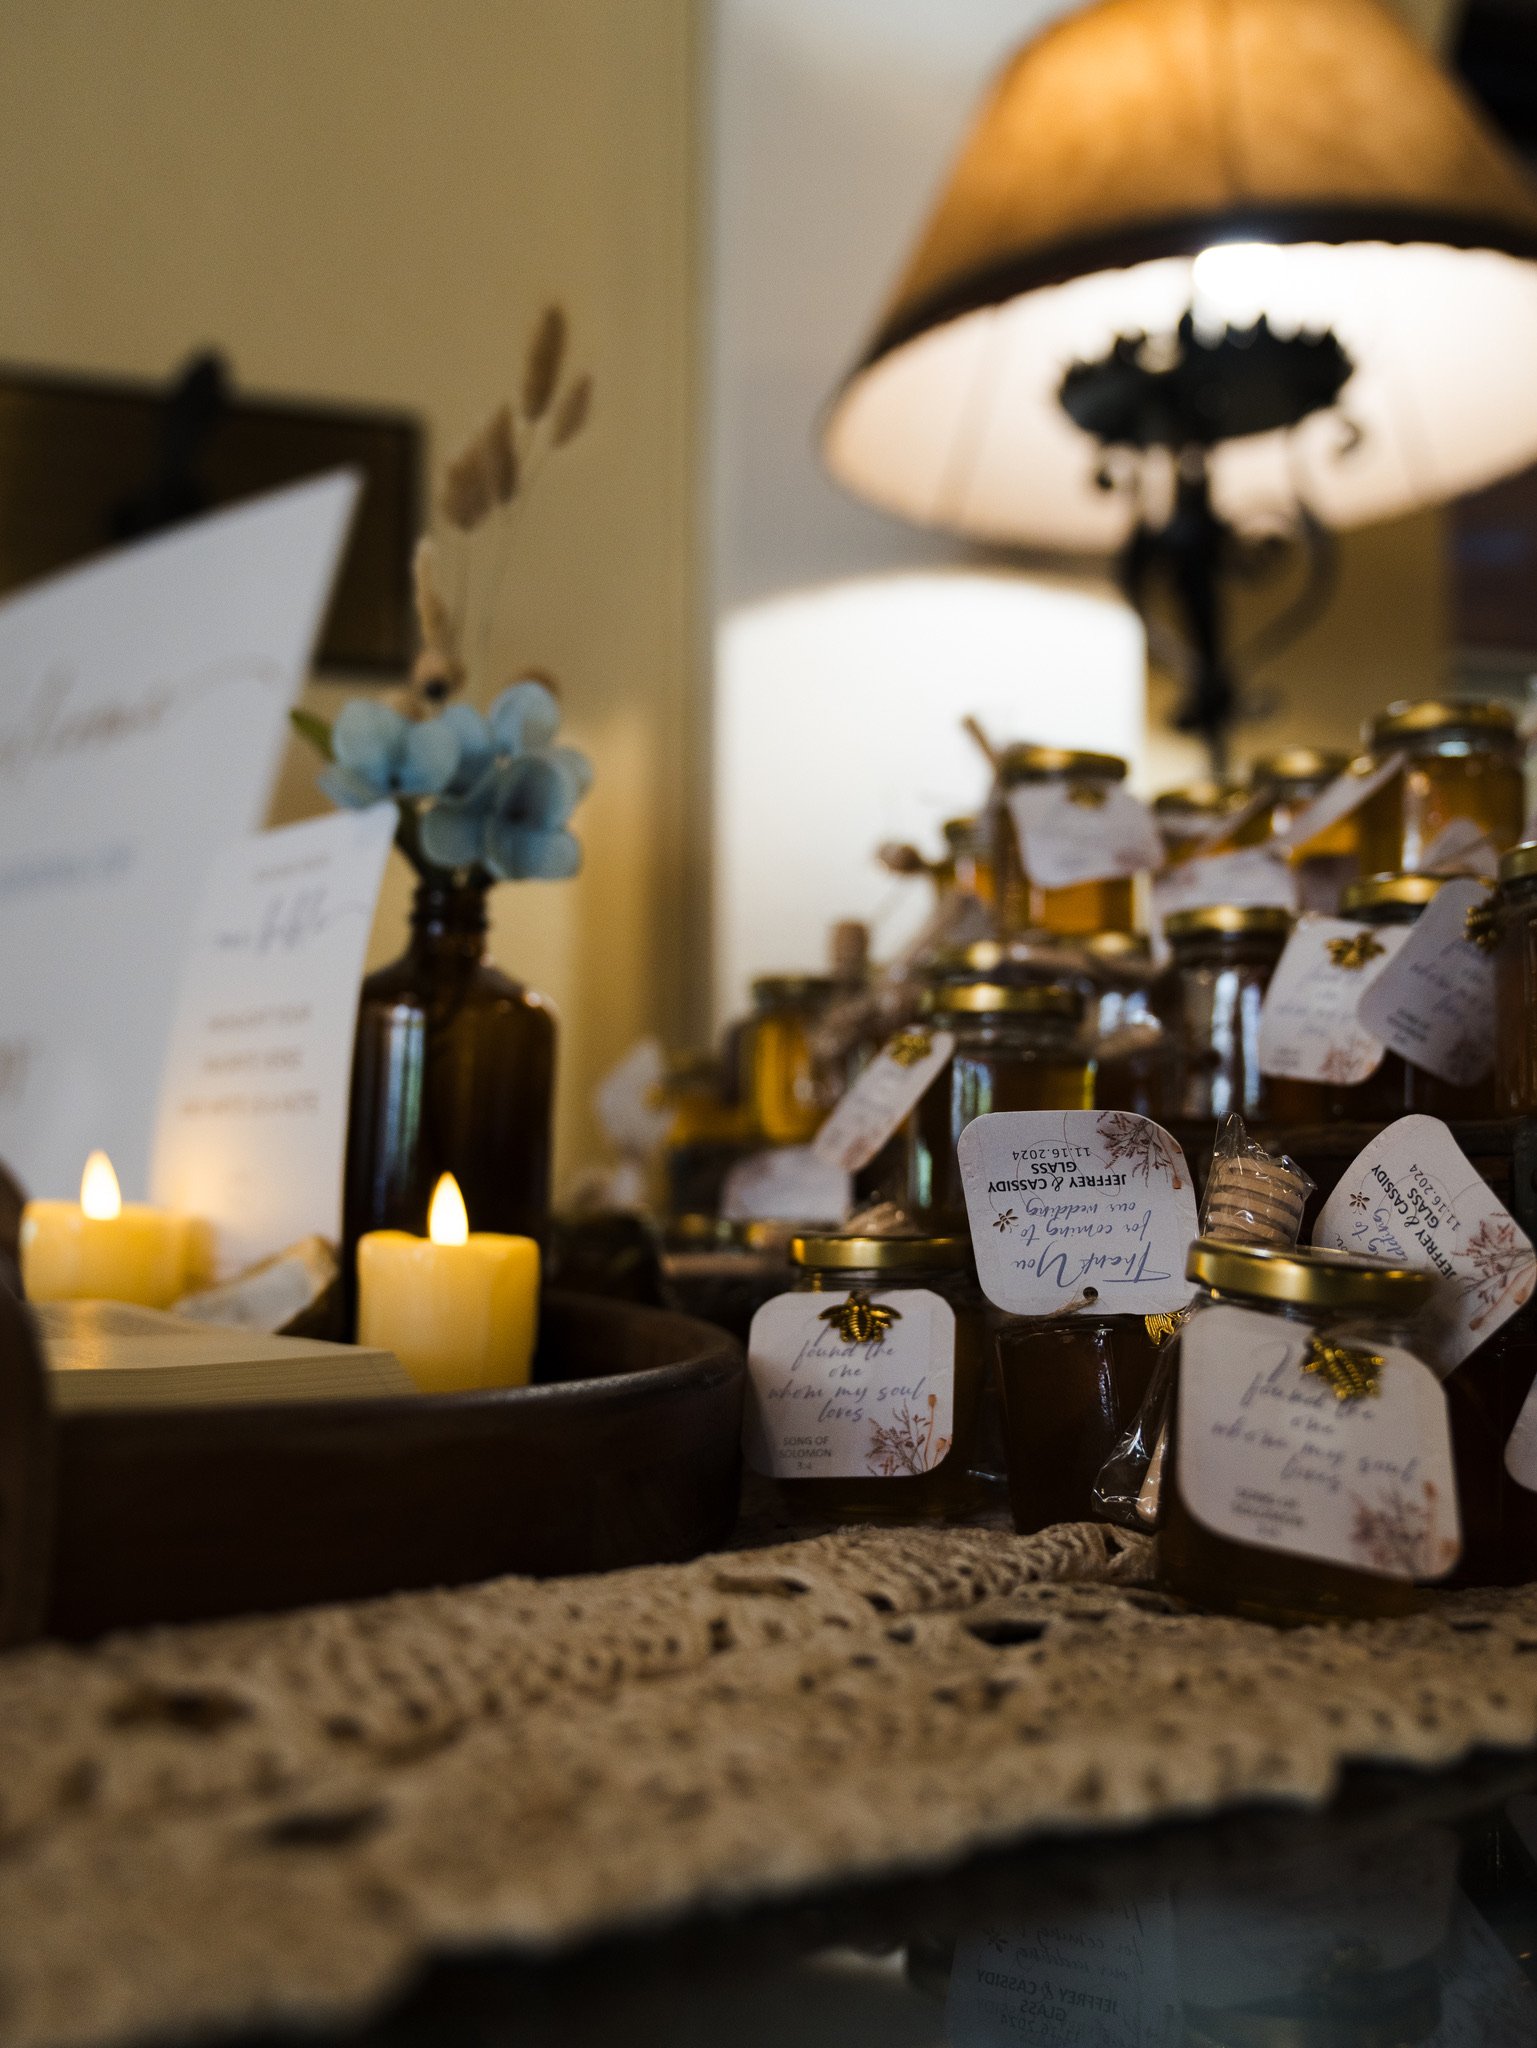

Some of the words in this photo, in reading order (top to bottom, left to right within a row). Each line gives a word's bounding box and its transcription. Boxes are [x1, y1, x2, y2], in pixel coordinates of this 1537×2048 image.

[1012, 1147, 1091, 1160] 11.16.2024
[1031, 1161, 1077, 1174] GLASS
[988, 1178, 1047, 1193] CASSIDY
[1051, 1177, 1064, 1192] &
[1068, 1174, 1127, 1188] JEFFREY
[1371, 1164, 1408, 1215] CASSIDY
[1026, 1198, 1098, 1220] wedding
[1109, 1201, 1136, 1212] our
[1407, 1188, 1439, 1229] GLASS
[1409, 1164, 1461, 1232] 11.16.2024
[1045, 1218, 1113, 1238] coming
[1124, 1210, 1151, 1240] for
[1404, 1215, 1420, 1228] &
[1020, 1224, 1040, 1246] to
[1013, 1240, 1085, 1287] You
[1081, 1241, 1171, 1283] Thank
[1415, 1229, 1457, 1280] JEFFREY
[792, 1341, 857, 1371] found
[829, 1362, 863, 1378] one
[768, 1380, 823, 1399] whom
[835, 1387, 868, 1403] my
[877, 1377, 925, 1401] soul
[818, 1400, 864, 1422] loves
[783, 1436, 812, 1446] SONG
[815, 1436, 829, 1446] OF
[779, 1448, 832, 1458] SOLOMON
